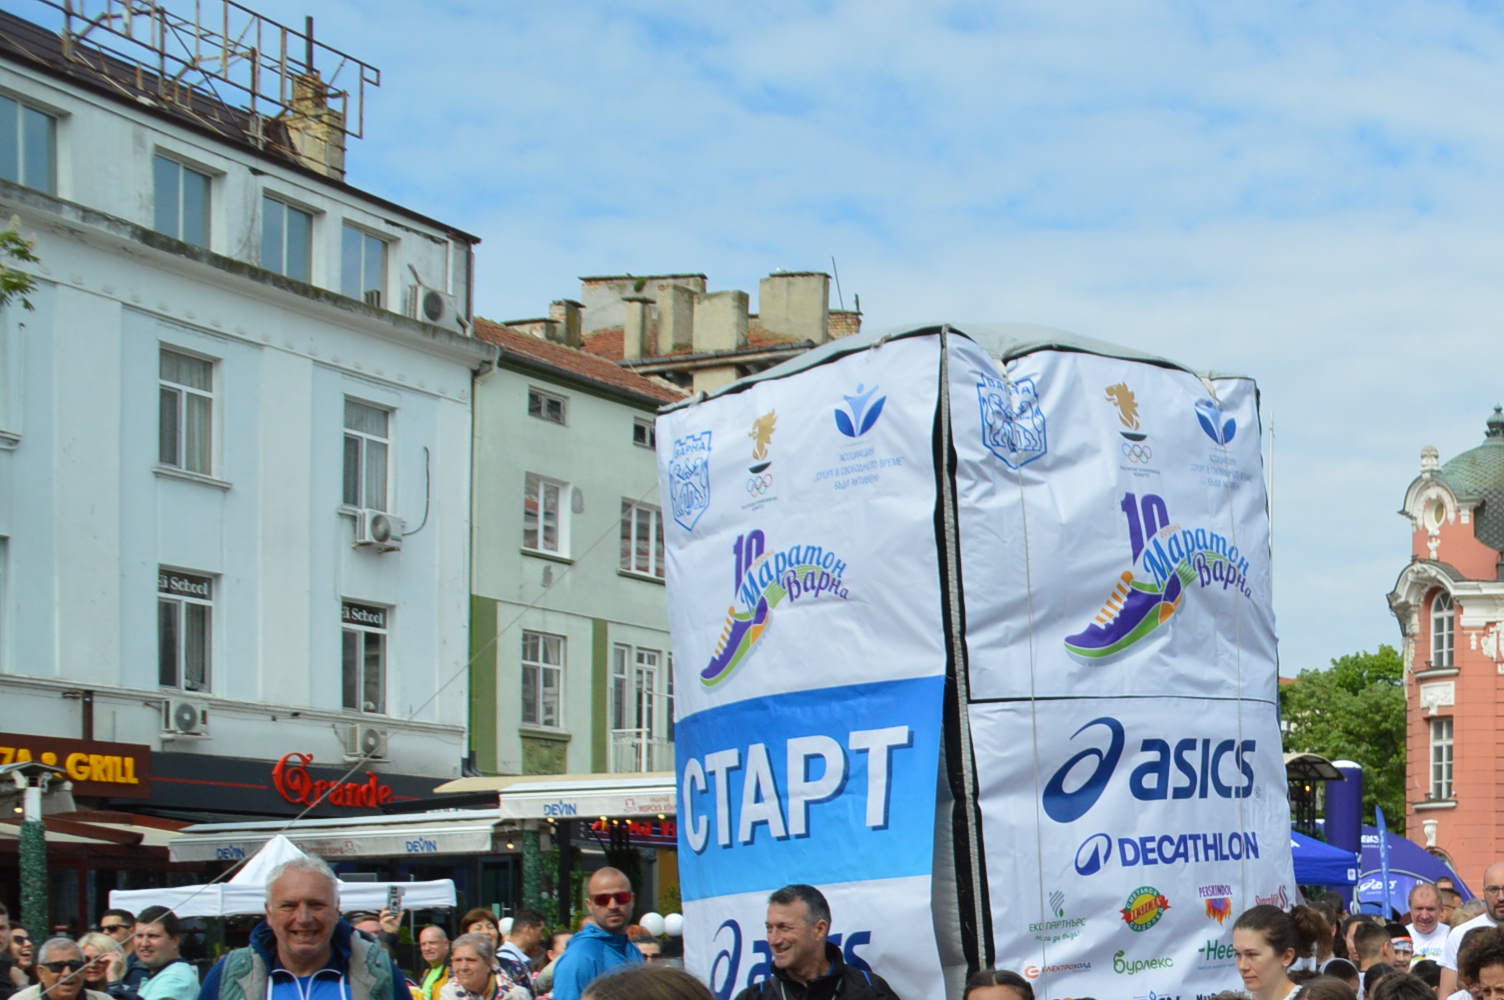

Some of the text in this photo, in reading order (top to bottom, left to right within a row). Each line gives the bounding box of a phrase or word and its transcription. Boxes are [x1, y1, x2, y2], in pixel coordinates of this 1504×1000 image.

[739, 543, 848, 611] Маратон
[1142, 527, 1251, 592] Маратон
[1193, 552, 1253, 600] Варна
[782, 568, 849, 602] Варна
[65, 752, 140, 785] GRILL
[682, 725, 913, 853] СТАРТ
[543, 801, 577, 816] DEVIN
[406, 837, 438, 852] DEVIN
[1118, 832, 1260, 867] DECATHLON
